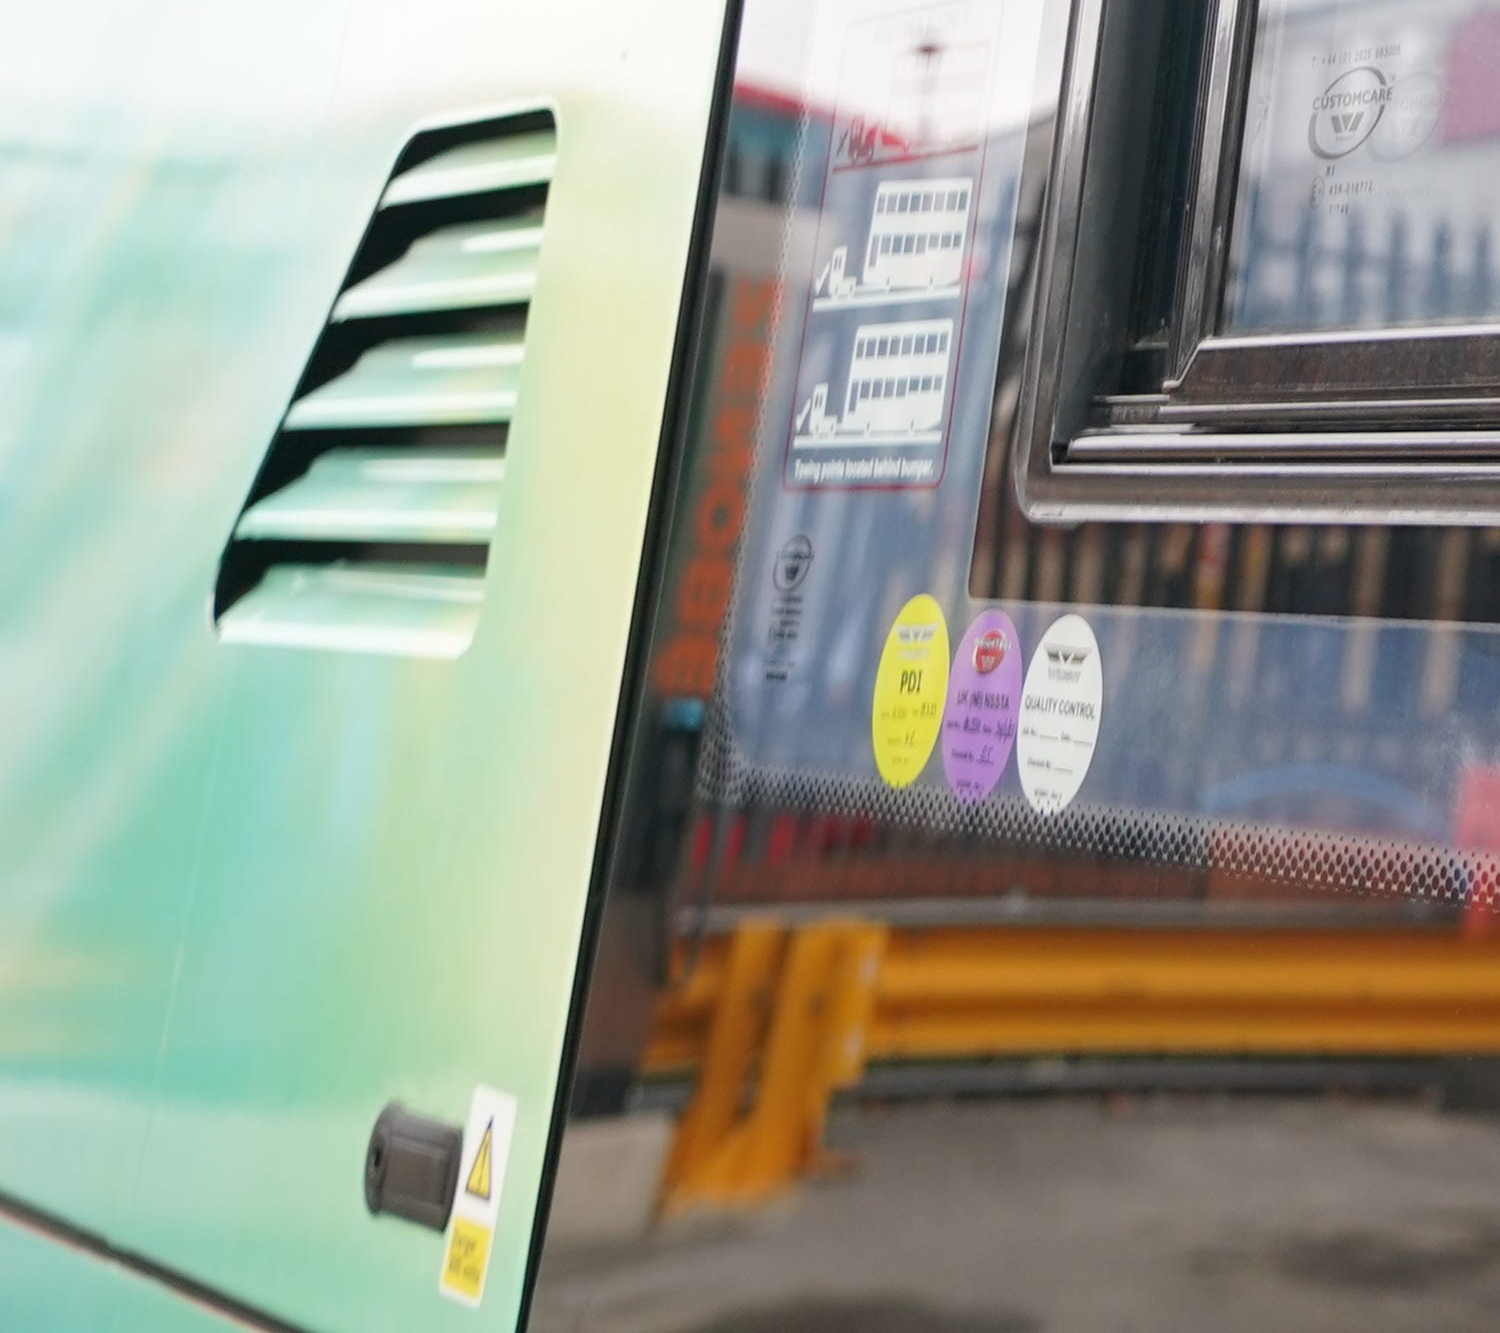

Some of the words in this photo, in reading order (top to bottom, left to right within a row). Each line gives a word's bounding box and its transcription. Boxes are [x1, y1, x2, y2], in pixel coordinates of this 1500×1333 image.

[1313, 86, 1393, 110] CUSTOMCARE
[795, 458, 821, 485] Towing
[820, 458, 845, 483] points
[845, 456, 873, 479] located
[874, 456, 901, 479] behind
[901, 456, 934, 482] bumper.
[900, 669, 923, 694] PDI
[957, 689, 968, 707] UK
[1025, 694, 1057, 716] QUALITY
[1058, 698, 1095, 722] CONTROL
